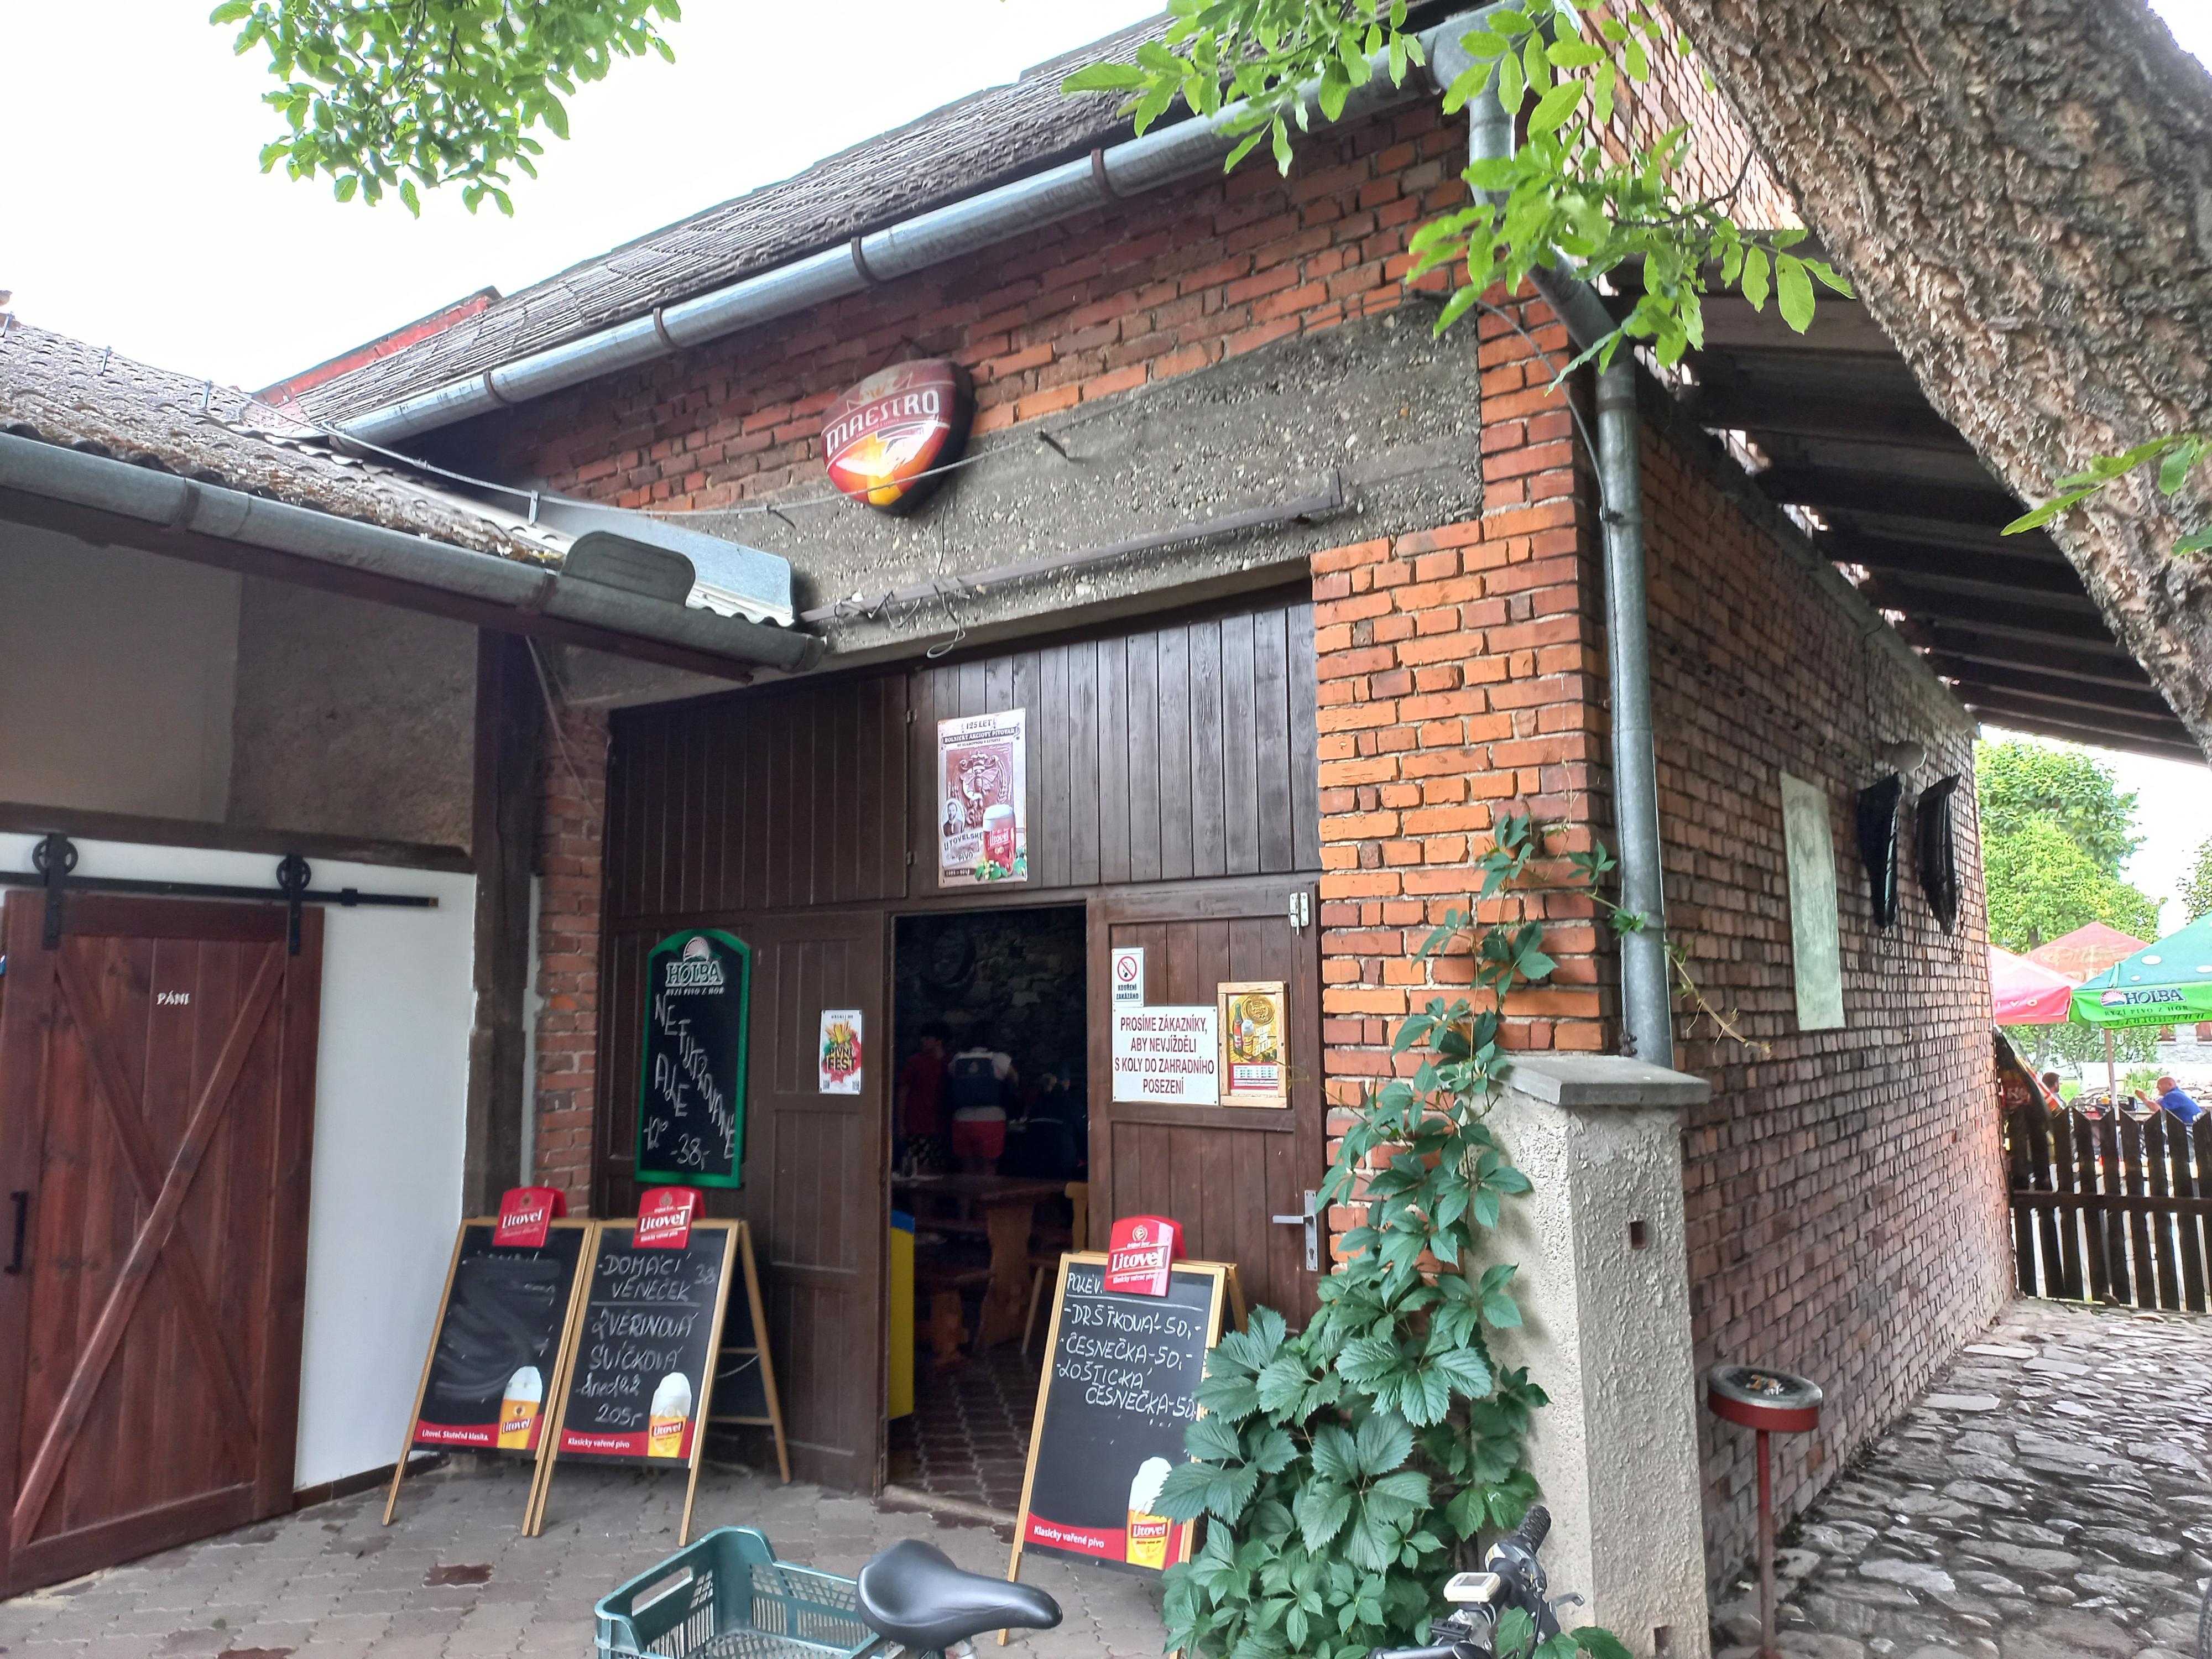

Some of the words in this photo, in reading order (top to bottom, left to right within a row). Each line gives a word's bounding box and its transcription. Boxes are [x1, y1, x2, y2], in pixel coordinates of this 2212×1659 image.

[825, 390, 940, 458] MAESTRO
[666, 961, 723, 986] HOLBA
[156, 990, 190, 1005] PÁNI
[1116, 992, 1139, 1000] ZAKÁZÁNO
[1996, 999, 2038, 1009] IVO
[2123, 988, 2185, 1005] HOLBA
[2104, 1008, 2126, 1016] RYZÍ
[1120, 1014, 1156, 1031] PROSÍME
[1159, 1014, 1208, 1035] ZÁKAZNÍKY,
[1131, 1037, 1147, 1052] ABY
[1150, 1035, 1196, 1053] NEVJÍŽDĚLI
[827, 1056, 857, 1071] FEST
[1114, 1057, 1120, 1072] S
[1122, 1057, 1142, 1073] KOLY
[1145, 1057, 1156, 1073] DO
[1159, 1056, 1214, 1074] ZAHRADNÍHO
[655, 1052, 690, 1118] ALE
[1143, 1077, 1184, 1095] POSEZENÍ
[502, 1208, 542, 1229] Litovel
[639, 1209, 686, 1233] Litovel
[1111, 1246, 1165, 1274] Litovel
[442, 1430, 468, 1441] Skutečná
[653, 1423, 681, 1437] Litovel
[567, 1437, 592, 1449] Klasicky
[593, 1439, 615, 1448] vařené
[615, 1440, 630, 1450] pivo
[1033, 1525, 1062, 1542] Klasicky
[1062, 1532, 1087, 1545] vařené
[1087, 1537, 1105, 1548] pivo
[1132, 1523, 1166, 1537] Litovel
